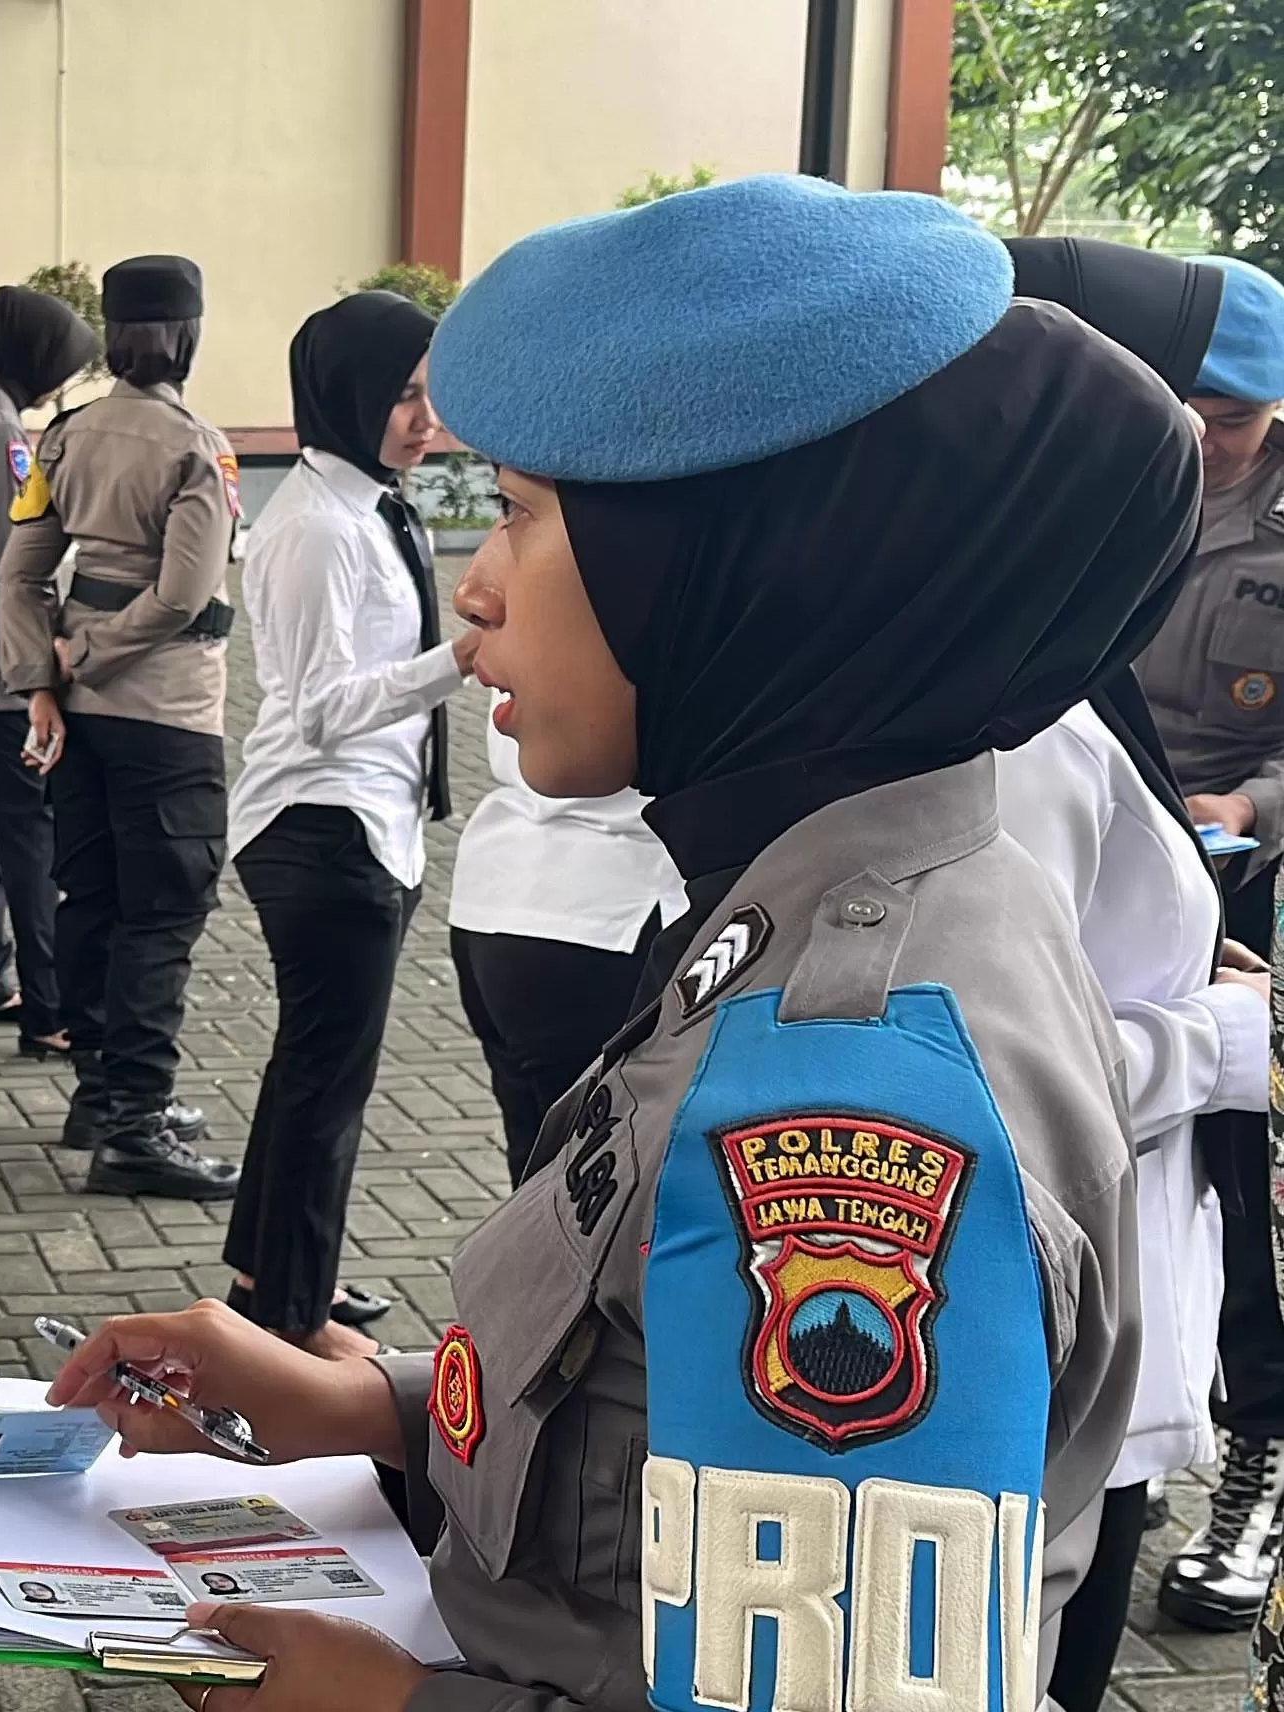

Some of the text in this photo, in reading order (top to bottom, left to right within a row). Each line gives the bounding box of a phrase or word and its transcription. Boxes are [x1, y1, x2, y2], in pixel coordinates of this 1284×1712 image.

[740, 1128, 946, 1178] POLRES
[746, 1152, 937, 1198] TEMANGGUNG
[758, 1197, 929, 1242] JAWA TENGAH
